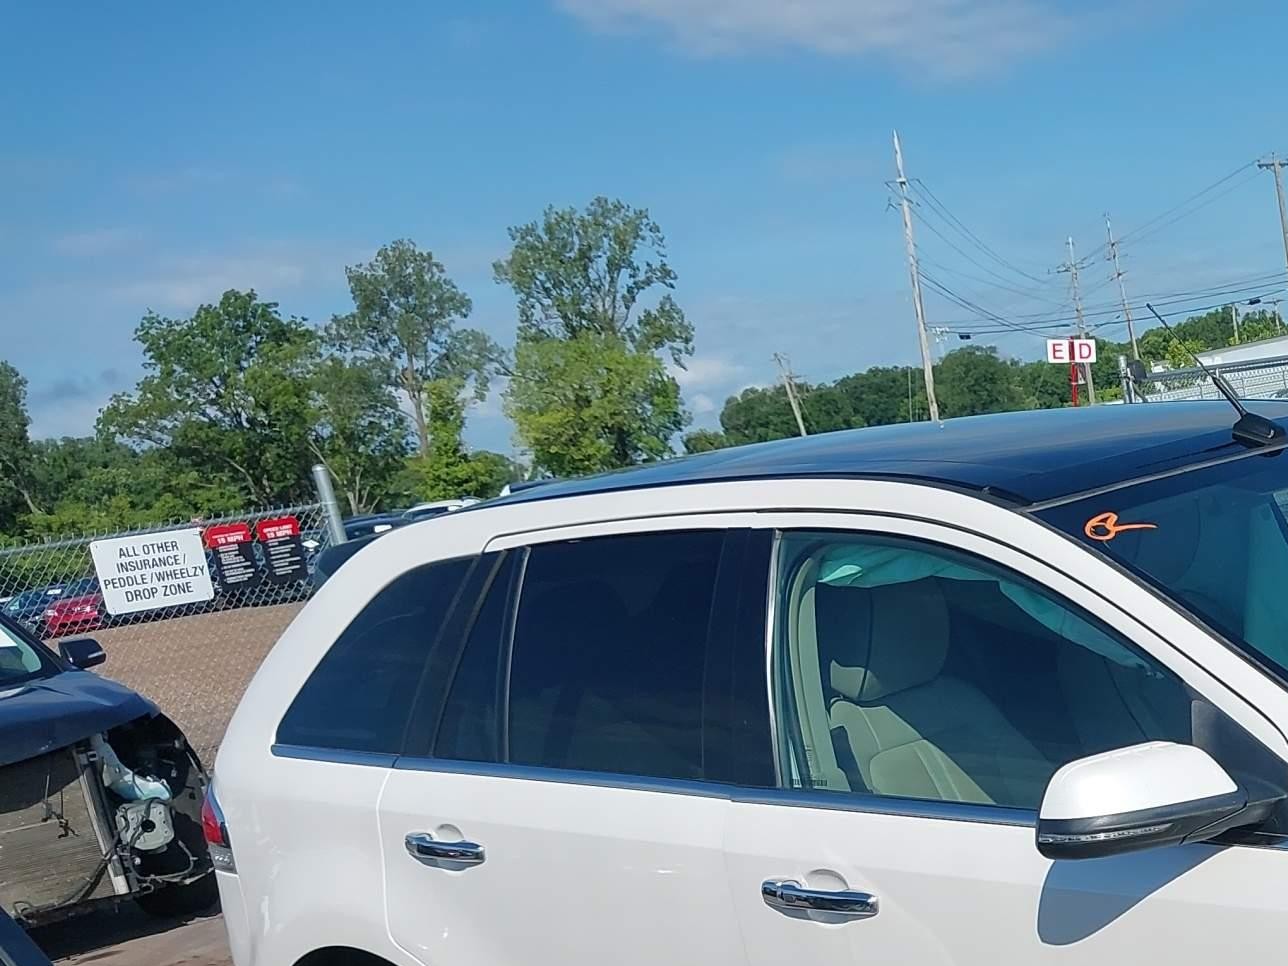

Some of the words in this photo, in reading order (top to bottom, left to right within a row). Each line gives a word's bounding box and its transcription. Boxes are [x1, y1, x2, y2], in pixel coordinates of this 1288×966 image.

[1052, 343, 1091, 359] ED
[119, 546, 140, 559] ALL
[142, 540, 179, 556] OTHER
[116, 554, 180, 574] INSURANCE
[125, 586, 158, 602] DROP
[162, 581, 194, 597] ZONE
